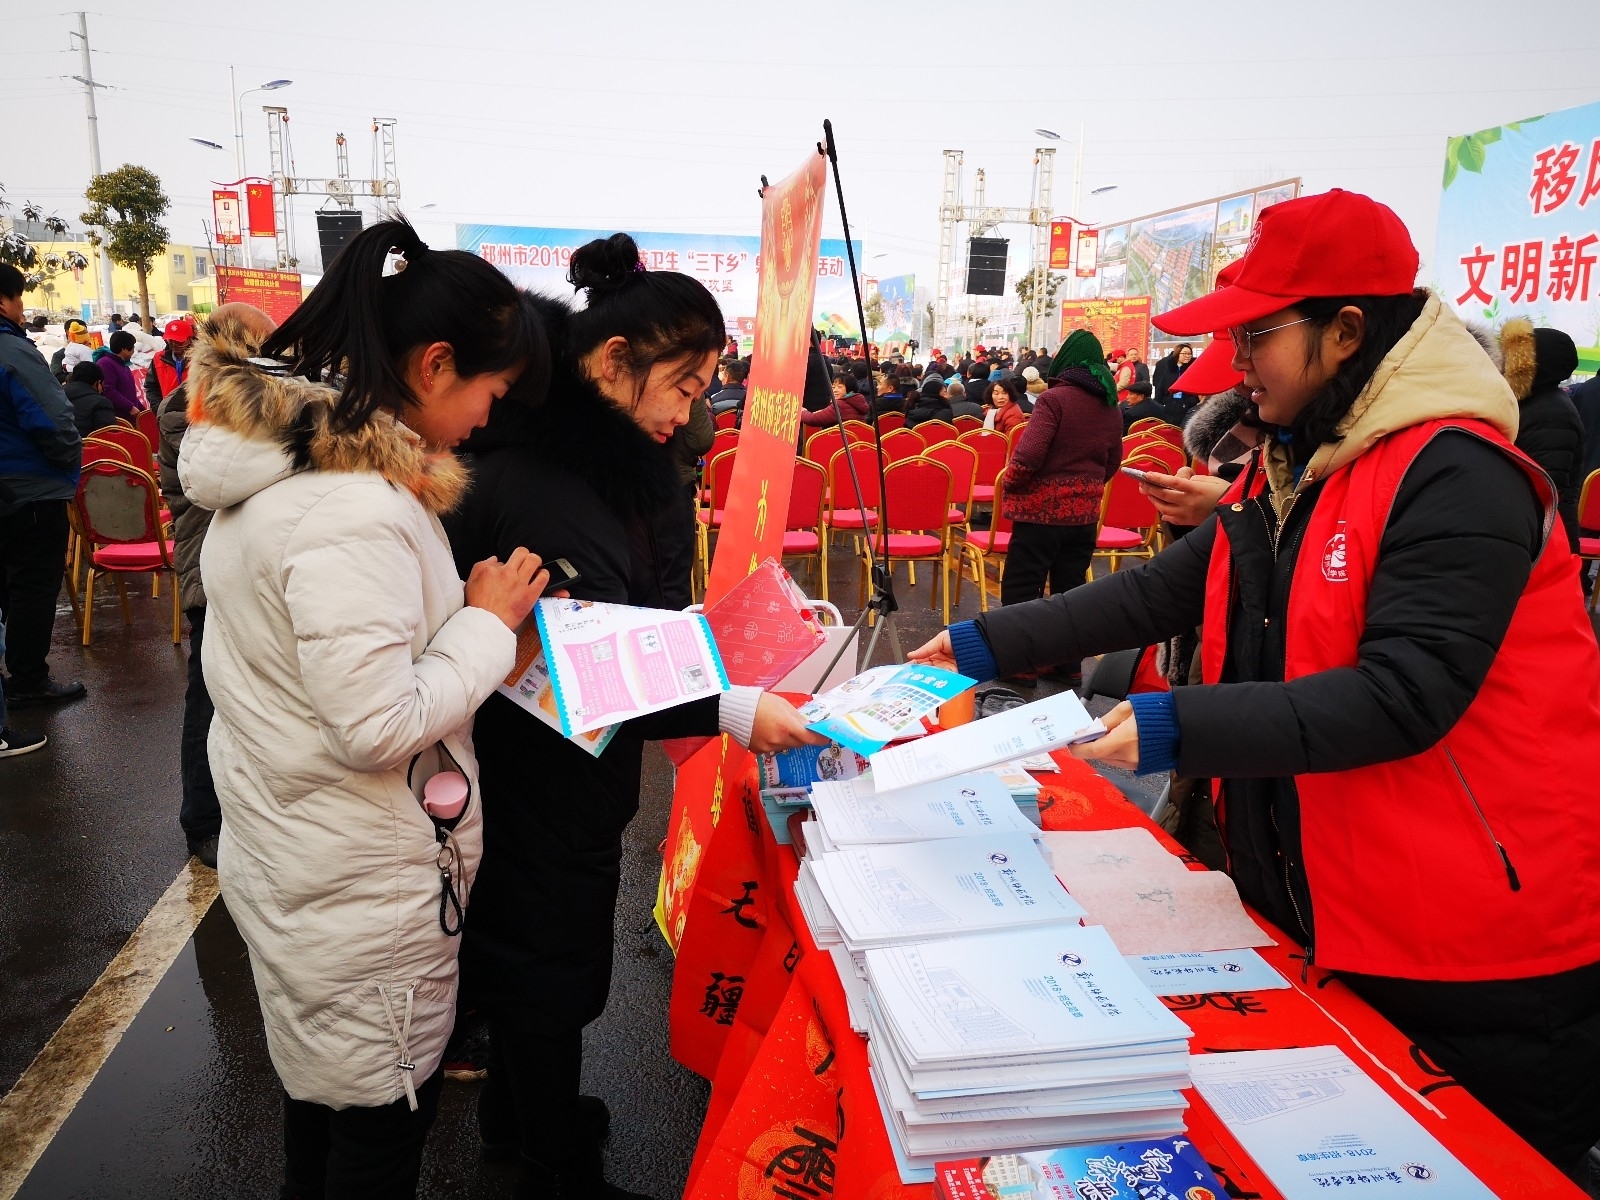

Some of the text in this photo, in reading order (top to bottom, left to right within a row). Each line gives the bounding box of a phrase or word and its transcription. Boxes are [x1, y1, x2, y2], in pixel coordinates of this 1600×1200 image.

[750, 385, 800, 445] 郑州师范学院
